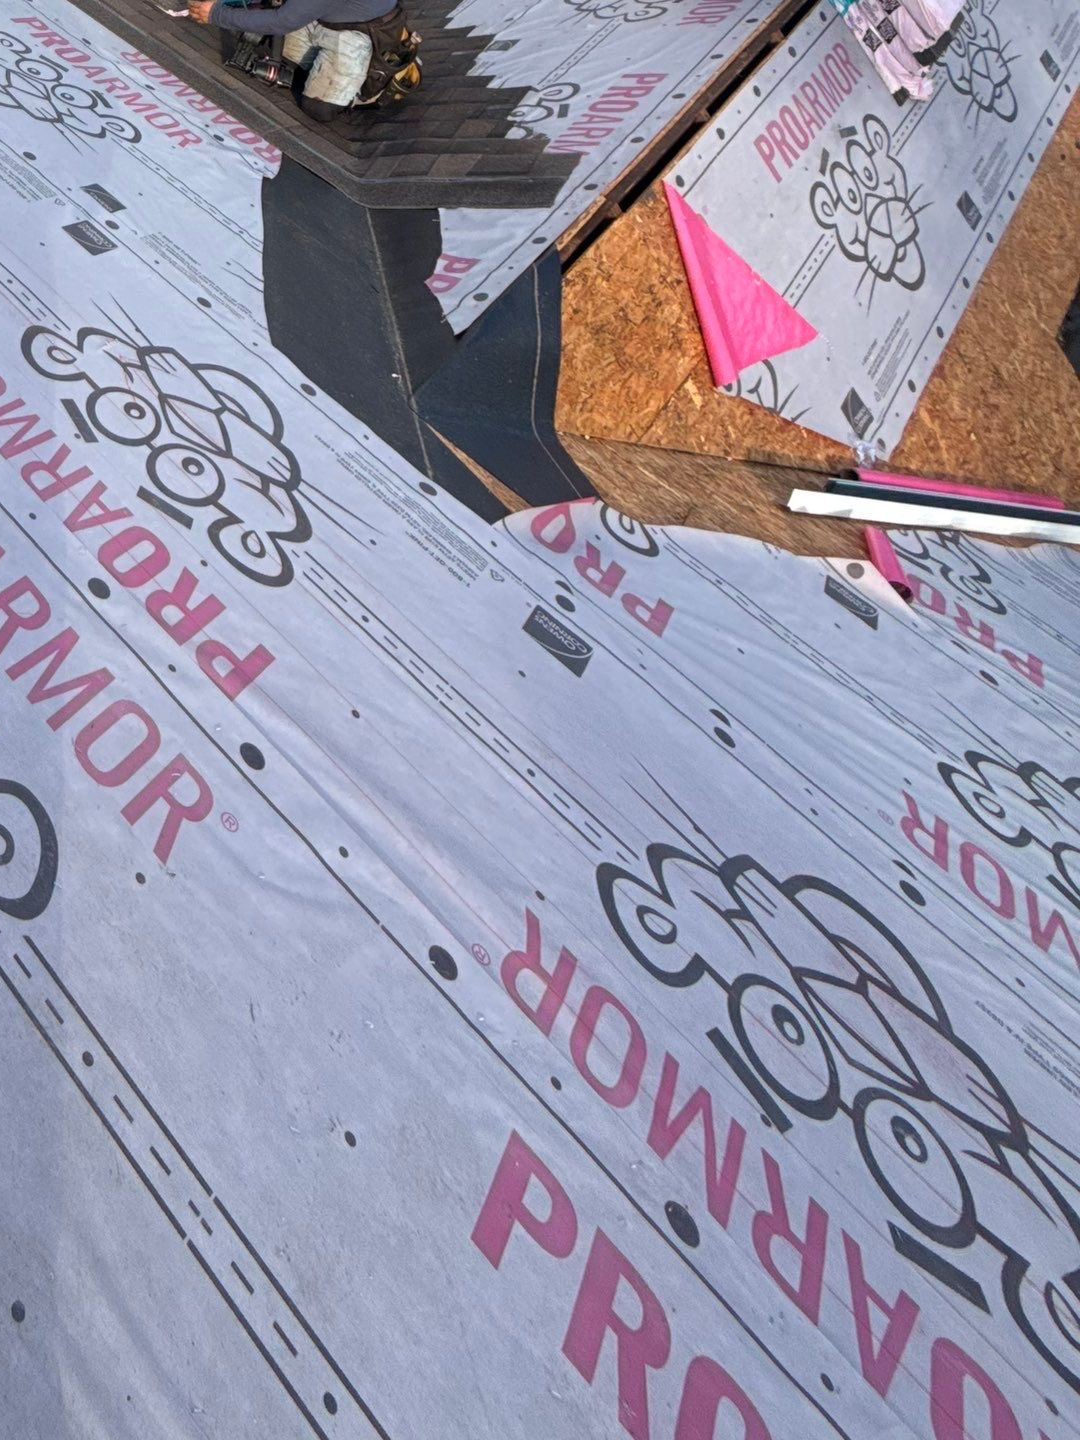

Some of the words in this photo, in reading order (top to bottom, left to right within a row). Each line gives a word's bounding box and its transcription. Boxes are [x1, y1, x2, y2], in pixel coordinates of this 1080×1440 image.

[11, 16, 202, 150] PROARMOR
[121, 49, 283, 165] ROARMOR
[753, 42, 863, 184] PROARMOR
[535, 609, 588, 655] CORNING
[535, 615, 576, 651] OWENS
